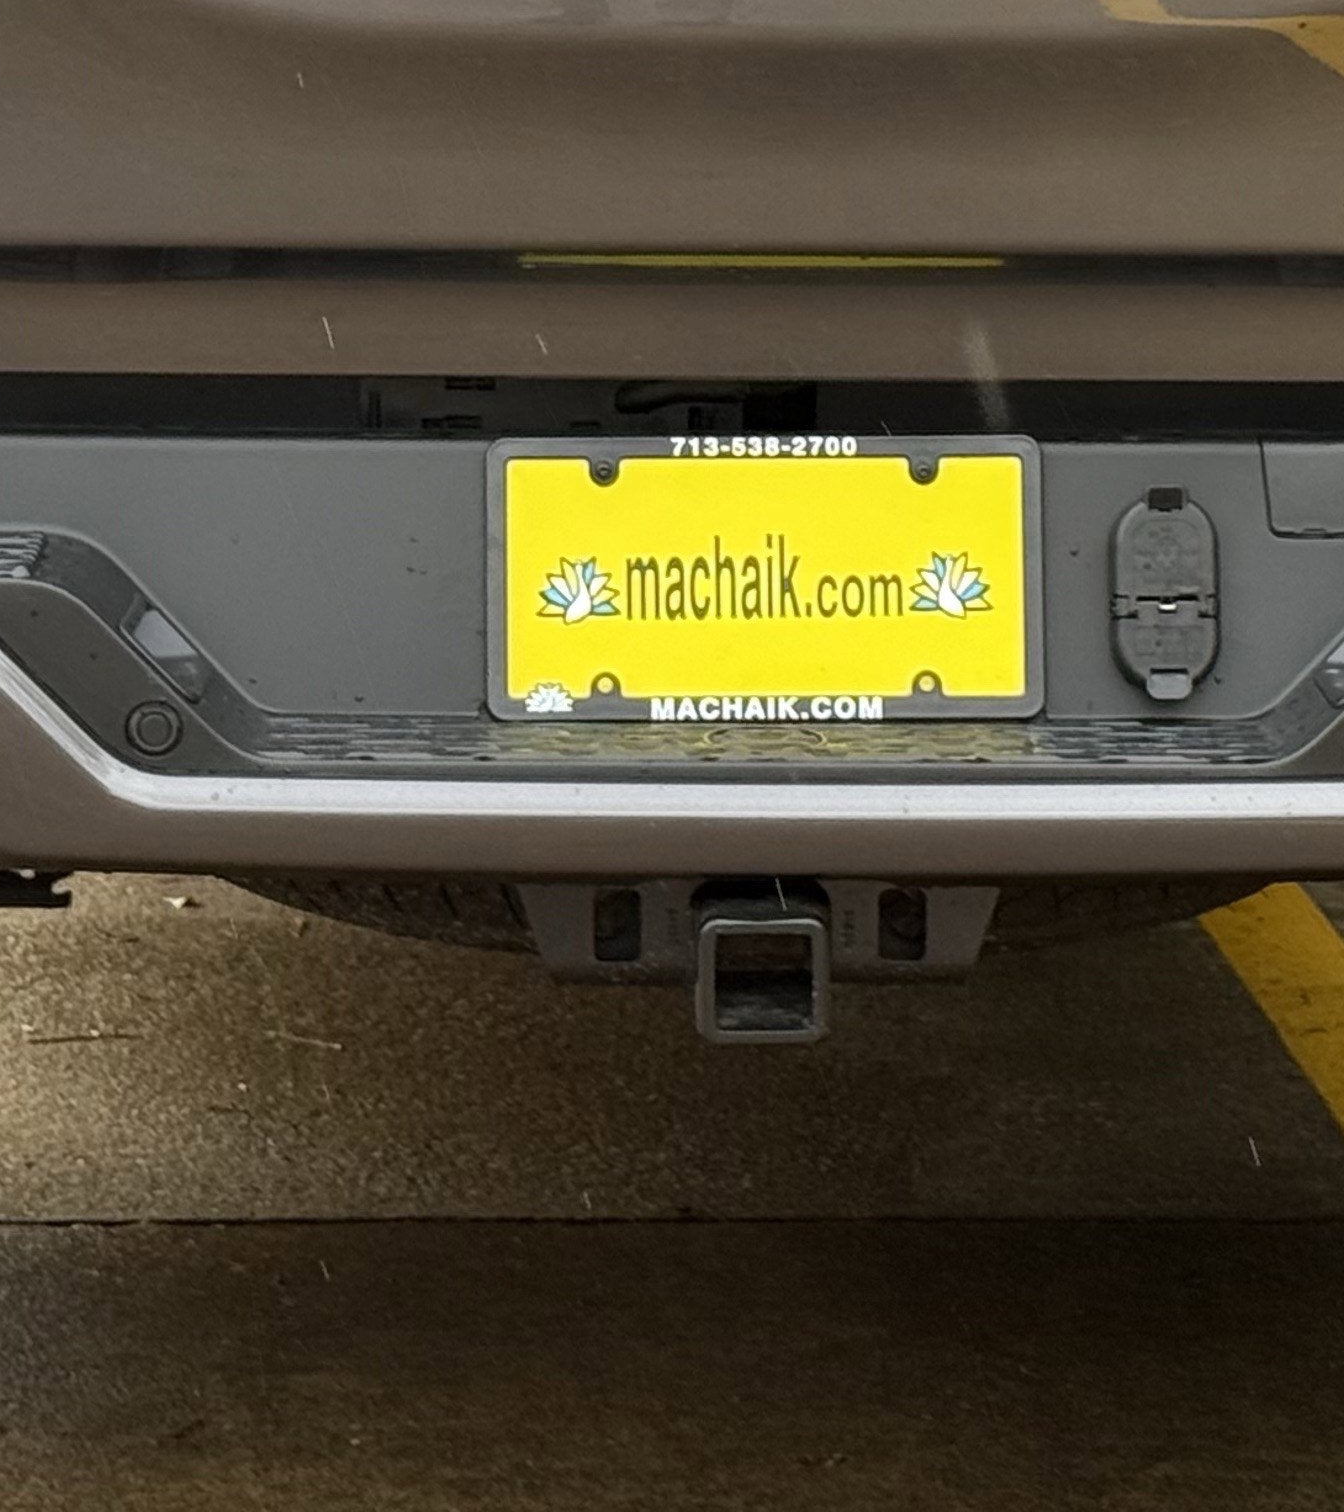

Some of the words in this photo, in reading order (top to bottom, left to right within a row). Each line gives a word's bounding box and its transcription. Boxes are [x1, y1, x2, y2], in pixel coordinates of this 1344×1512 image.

[669, 435, 858, 458] 713-538-2700
[625, 534, 905, 621] machaik.com
[649, 696, 885, 721] MACHAIK.COM
